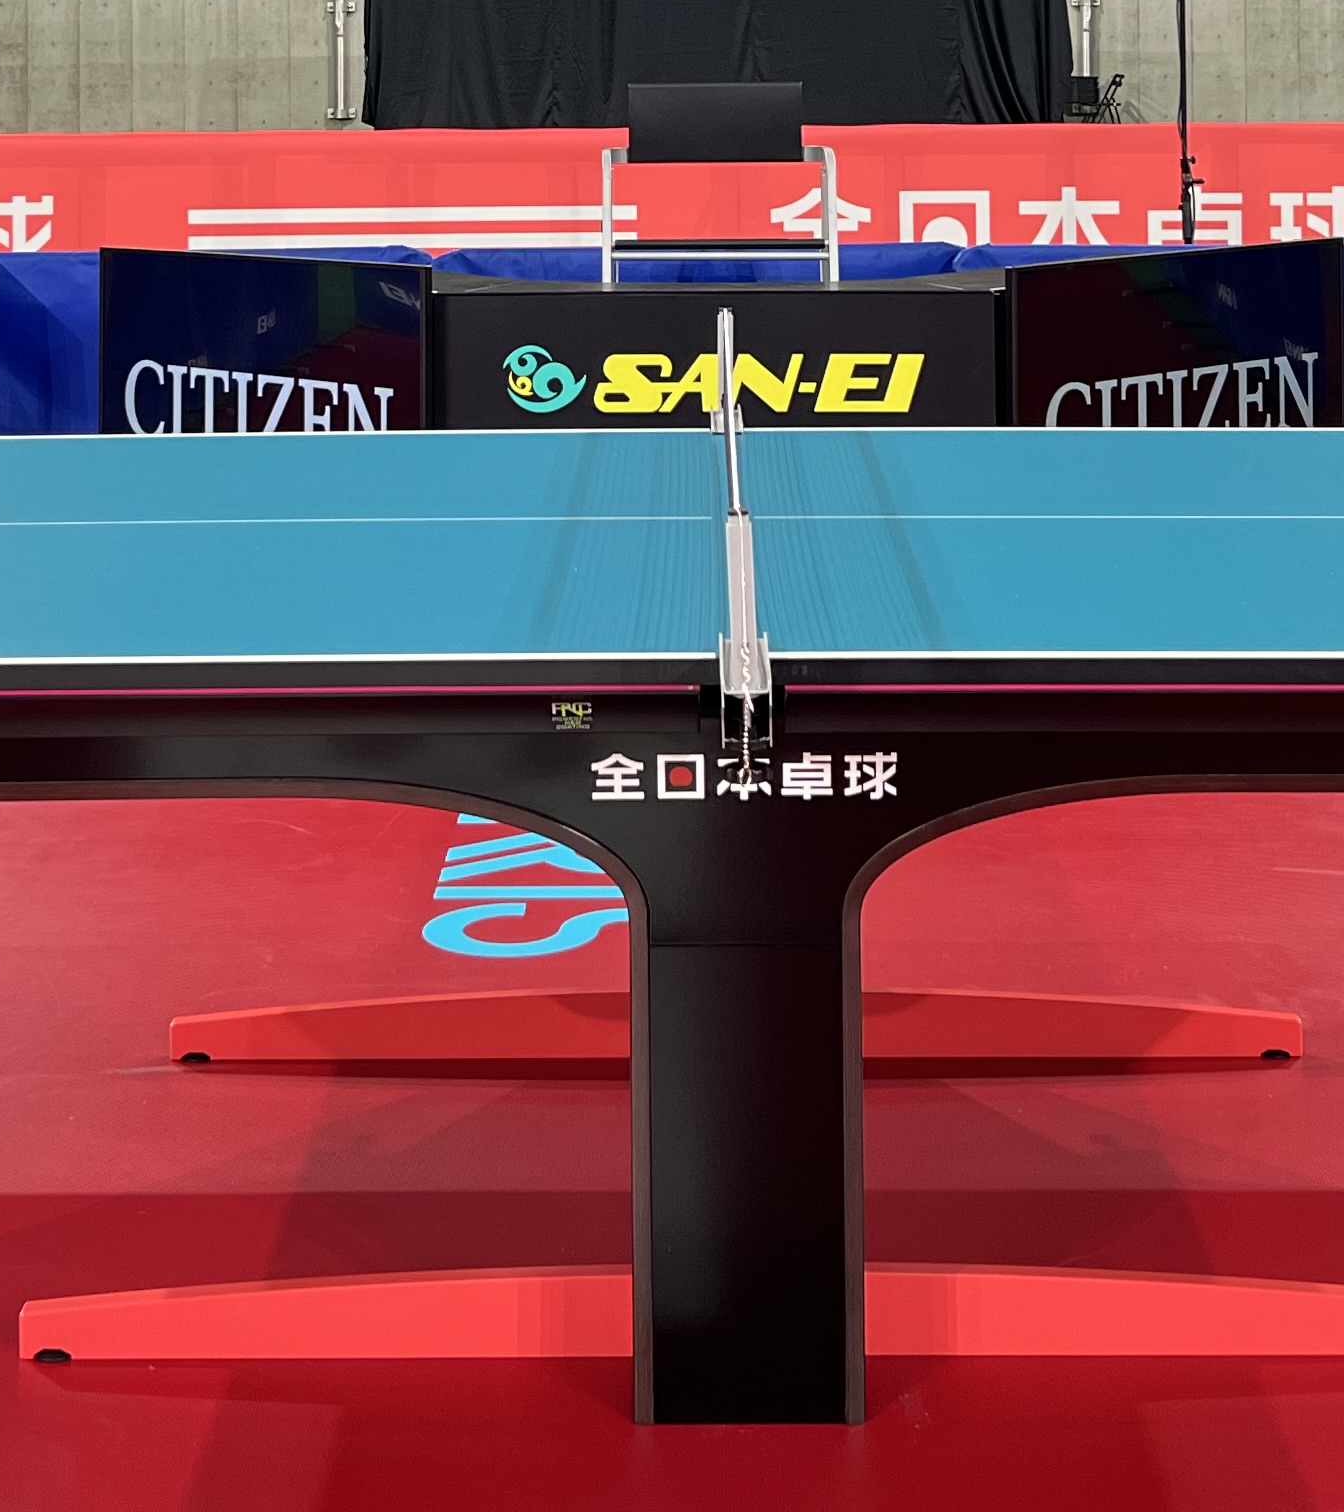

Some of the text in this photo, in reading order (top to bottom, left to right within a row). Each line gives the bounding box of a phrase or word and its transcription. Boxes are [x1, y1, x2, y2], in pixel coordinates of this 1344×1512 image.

[124, 359, 394, 433] CITIZEN
[593, 354, 925, 413] SAN-EI
[1045, 352, 1318, 428] CITIZEN
